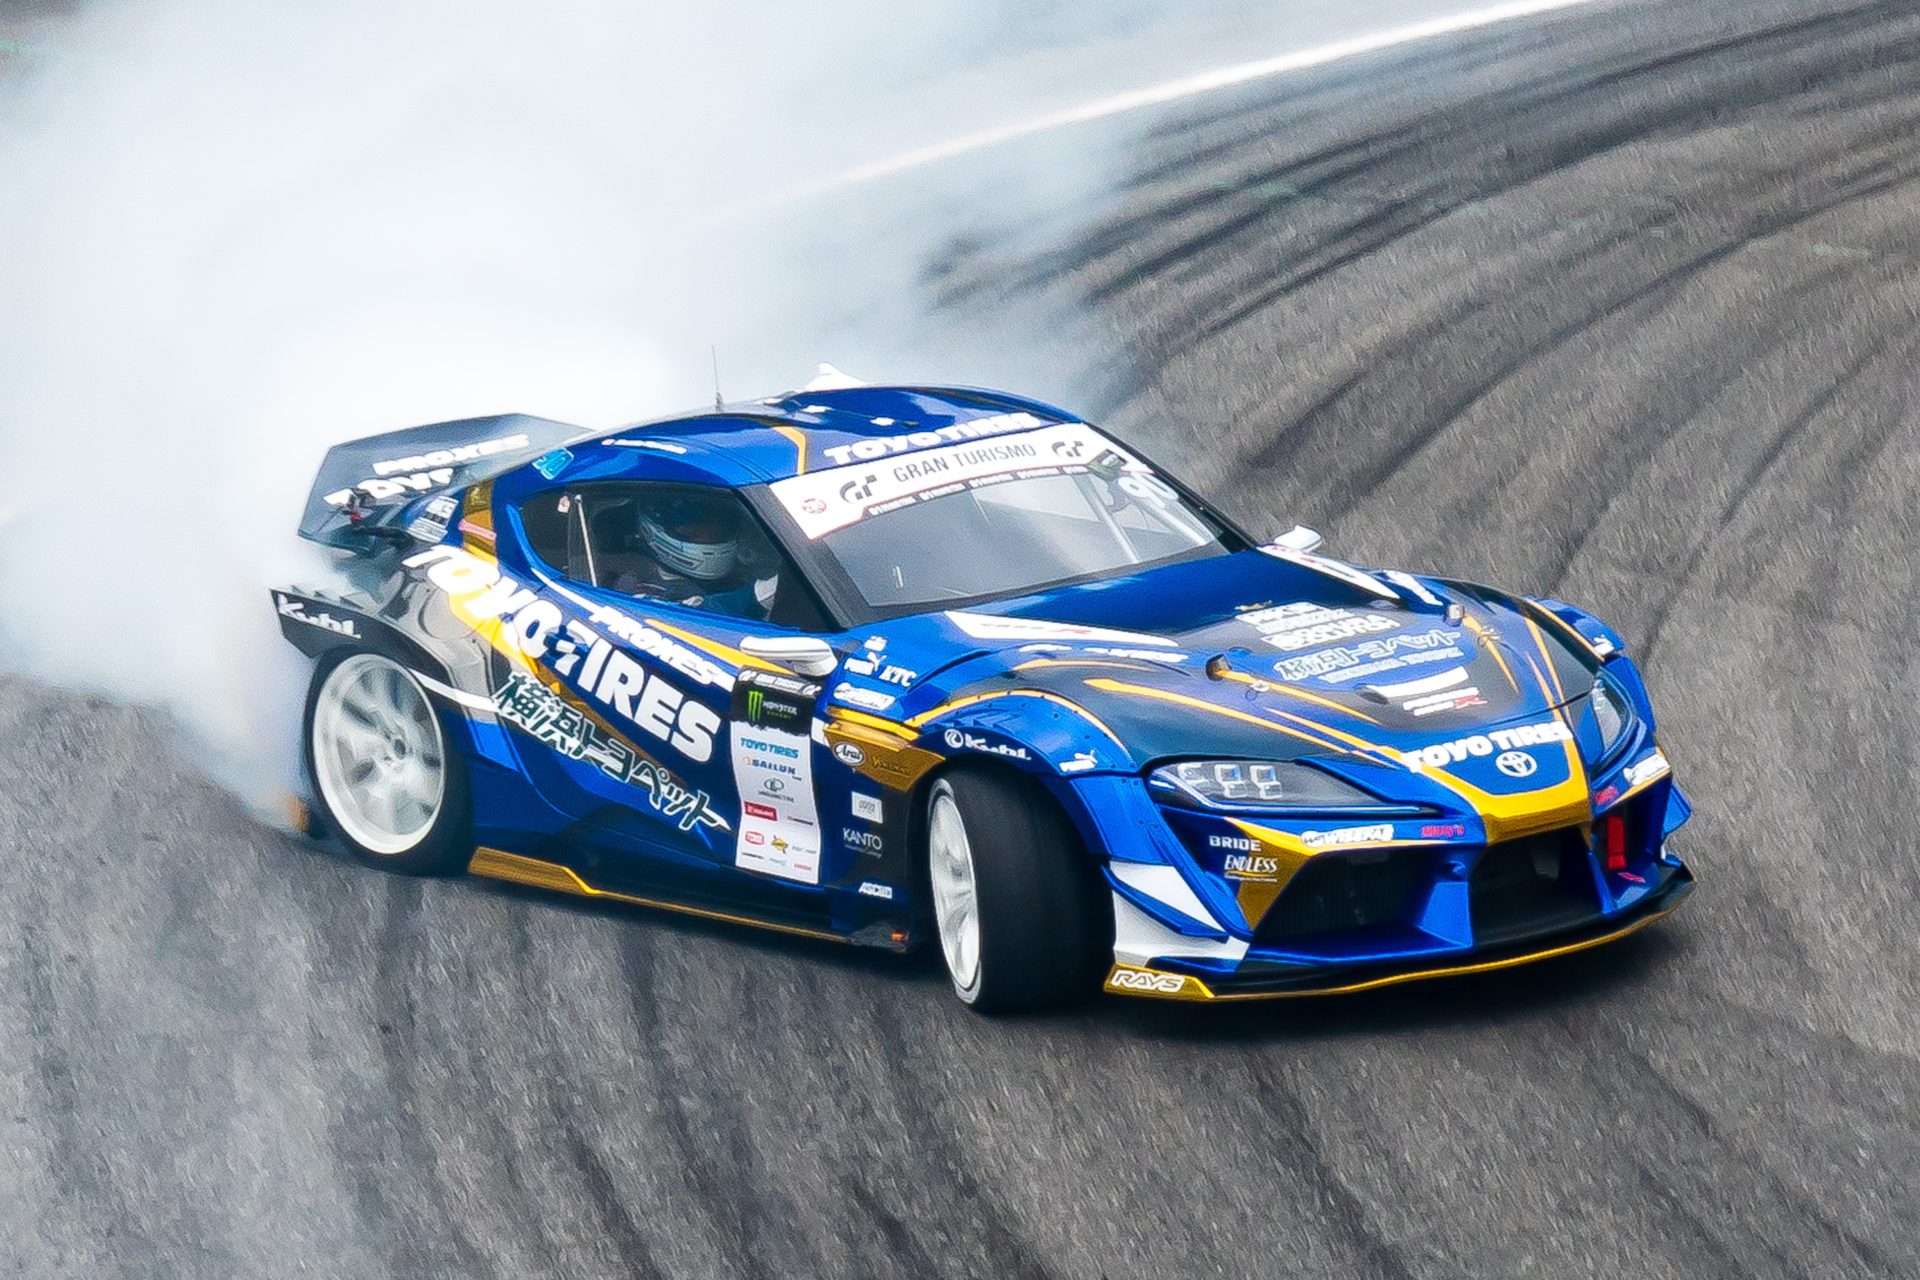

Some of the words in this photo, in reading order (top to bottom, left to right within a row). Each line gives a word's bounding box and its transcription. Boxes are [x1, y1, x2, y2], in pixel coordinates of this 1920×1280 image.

[824, 431, 942, 466] TOYO
[893, 456, 950, 483] GRAN
[955, 443, 1037, 467] TURISMO
[879, 665, 917, 687] KTC
[741, 738, 767, 752] TOYO
[769, 744, 799, 759] TIRES
[1400, 735, 1493, 773] TOYO
[843, 827, 883, 850] KANTO
[1208, 835, 1262, 851] BRIDE
[1224, 854, 1278, 873] ENDLESS
[1111, 969, 1185, 993] RAYS
